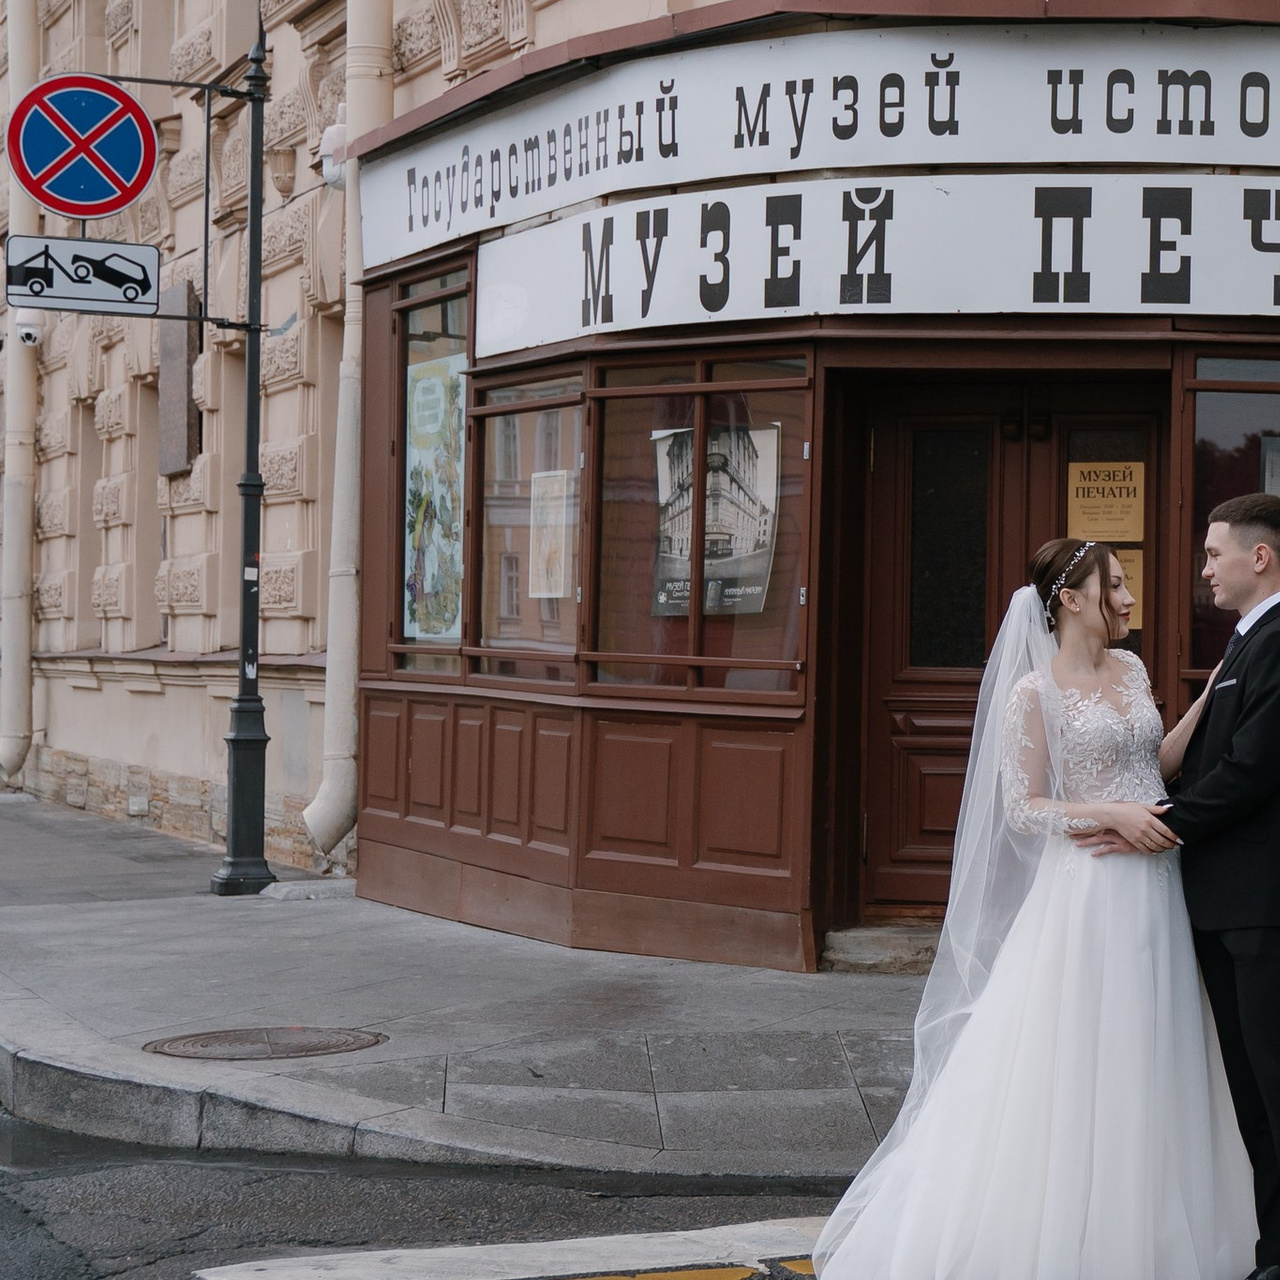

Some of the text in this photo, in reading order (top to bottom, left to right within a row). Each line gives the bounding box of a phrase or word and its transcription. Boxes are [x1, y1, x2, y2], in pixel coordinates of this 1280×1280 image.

[406, 78, 679, 234] Государственный
[734, 52, 961, 160] музей
[581, 186, 895, 328] МУЗЕЙ
[1075, 486, 1137, 499] ПЕЧАТИ
[1079, 466, 1133, 482] МУЗЕЙ
